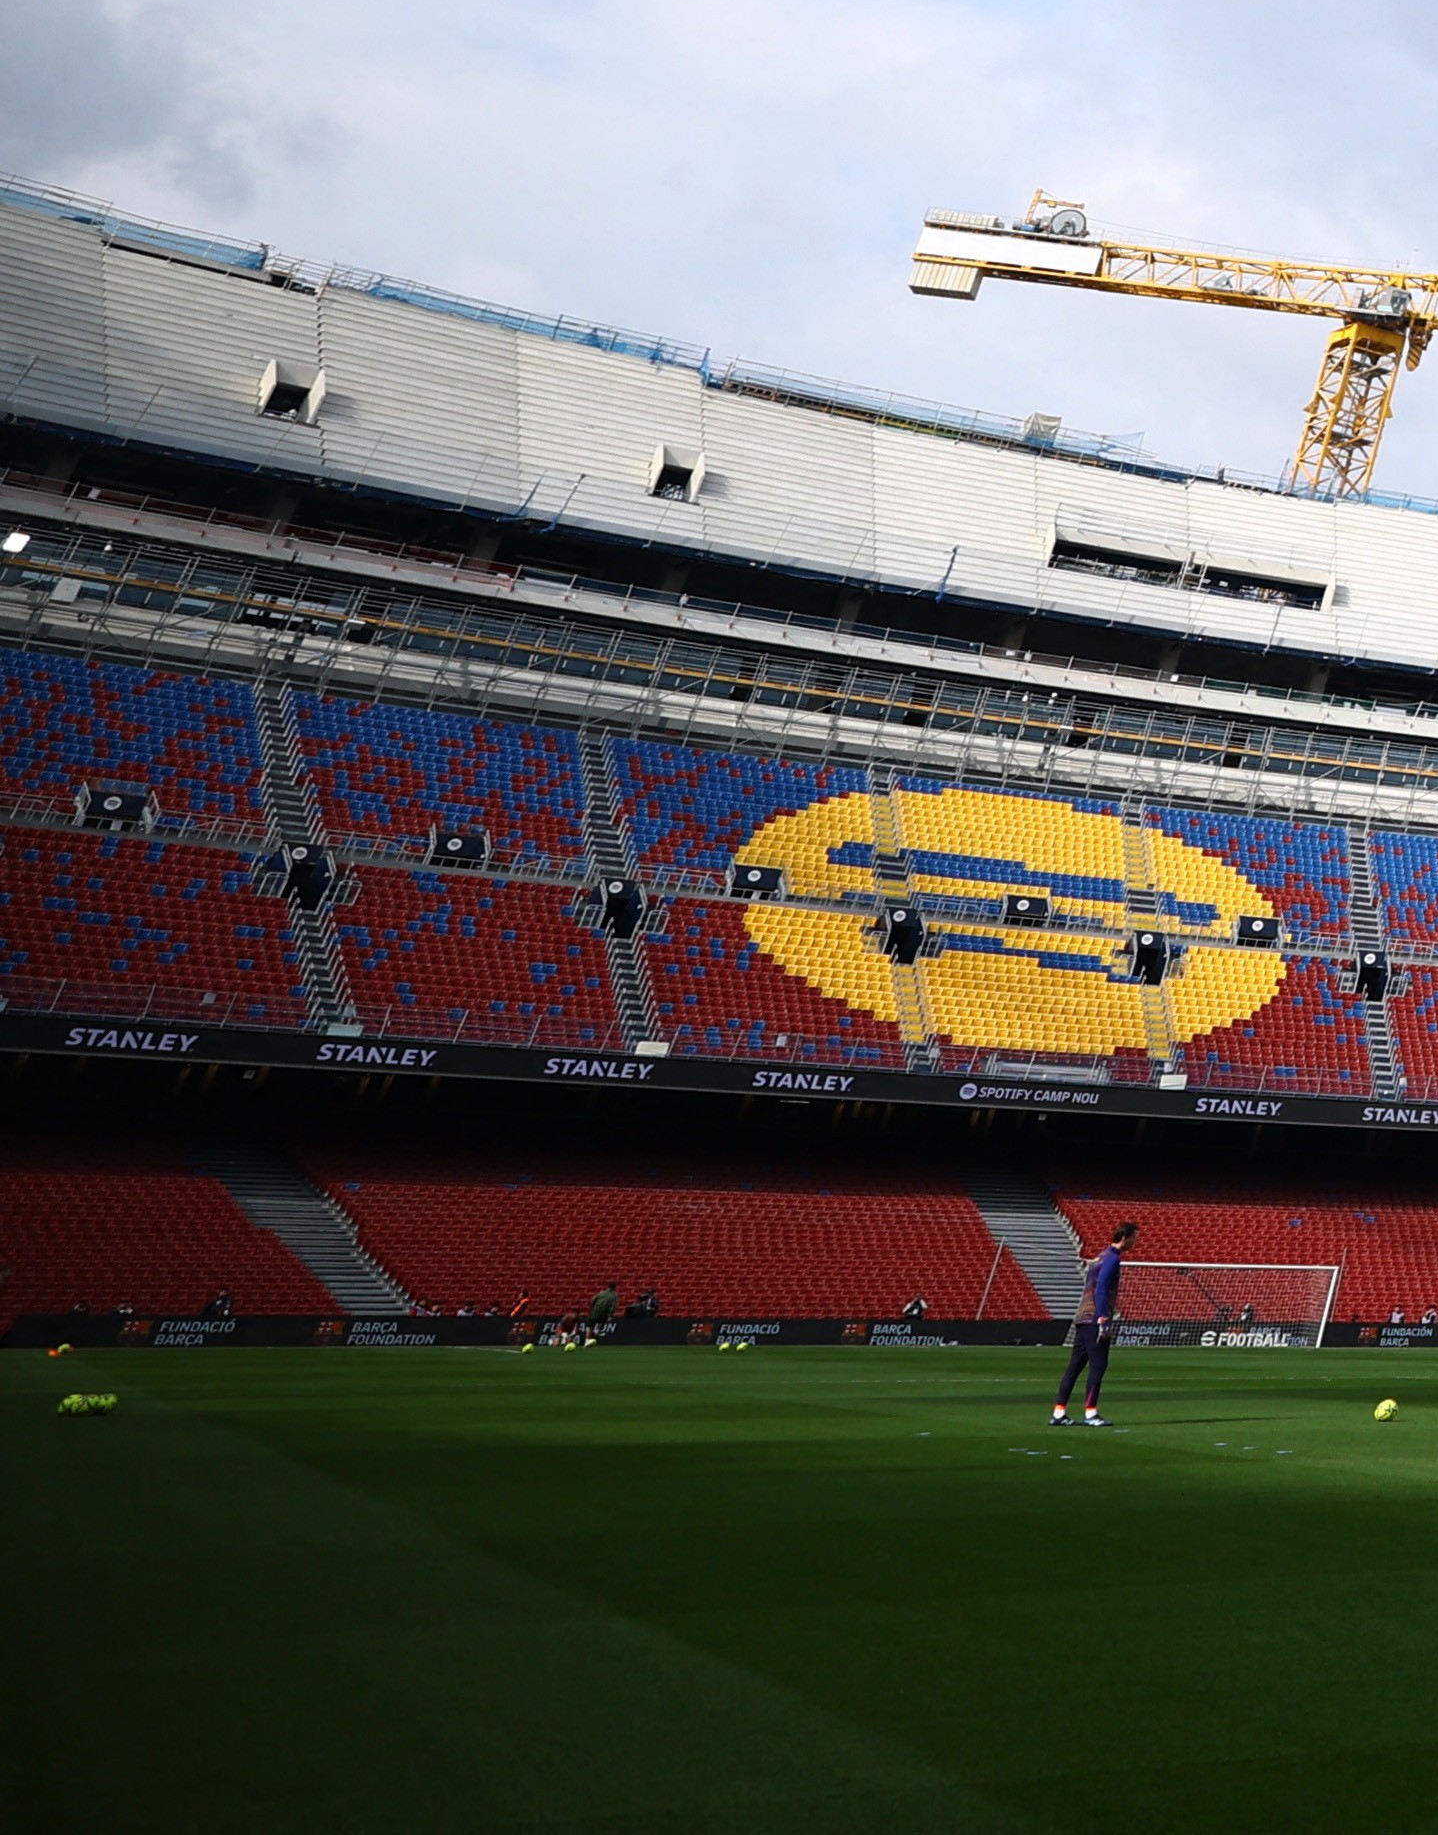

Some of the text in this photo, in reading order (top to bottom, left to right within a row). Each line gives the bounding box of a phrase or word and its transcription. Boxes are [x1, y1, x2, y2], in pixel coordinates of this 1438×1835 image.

[65, 1027, 199, 1053] STANLEY
[316, 1043, 438, 1068] STANLEY
[543, 1057, 655, 1081] STANLEY
[752, 1070, 855, 1093] STANLEY
[978, 1086, 1100, 1106] SPOTIFY CAMP NOU
[1195, 1098, 1283, 1117] STANLEY
[159, 1318, 236, 1333] FUNDACIÓ
[351, 1322, 399, 1335] BARÇA
[719, 1322, 781, 1335] FUNDACIÓ
[873, 1324, 912, 1336] BARÇA
[1382, 1325, 1433, 1337] FUNDACIÓN
[154, 1334, 204, 1347] BARÇA
[347, 1334, 436, 1346] FOUNDATION
[870, 1335, 944, 1347] FOUNDATION
[1380, 1337, 1410, 1348] BARÇA
